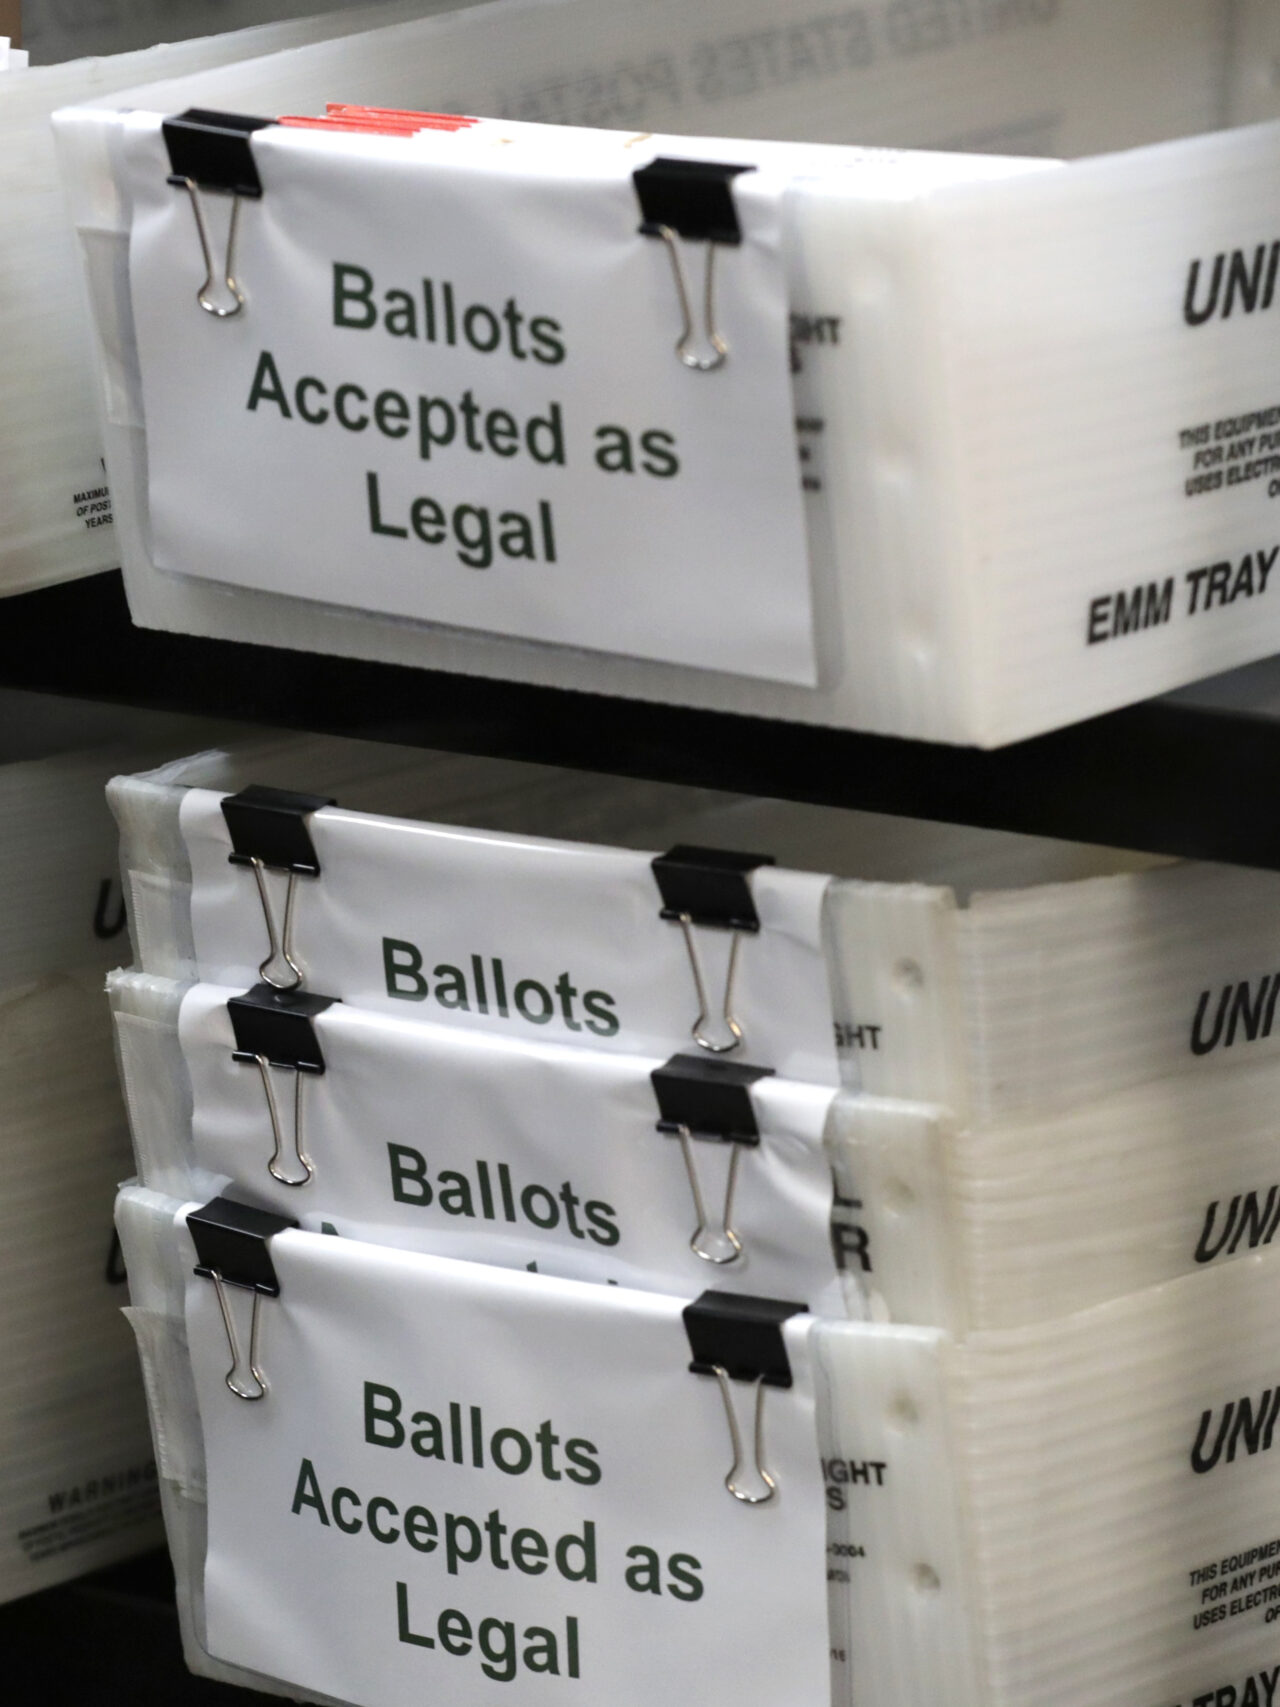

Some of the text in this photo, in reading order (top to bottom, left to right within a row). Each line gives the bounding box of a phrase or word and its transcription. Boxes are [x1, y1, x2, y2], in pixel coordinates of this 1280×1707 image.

[332, 261, 566, 366] Ballots
[246, 350, 680, 480] Accepted as
[1193, 445, 1224, 470] FOR
[1226, 437, 1257, 461] ANY
[365, 471, 558, 570] Legal
[1087, 545, 1280, 646] EMM TRAY
[382, 936, 621, 1037] Ballots
[386, 1141, 622, 1247] Ballots
[363, 1380, 603, 1486] Ballots
[290, 1457, 705, 1602] Accepted as
[1189, 1563, 1218, 1587] THIS
[395, 1580, 581, 1683] Legal
[1193, 1604, 1227, 1630] USES
[1201, 1581, 1228, 1605] FOR
[1229, 1569, 1257, 1594] ANY
